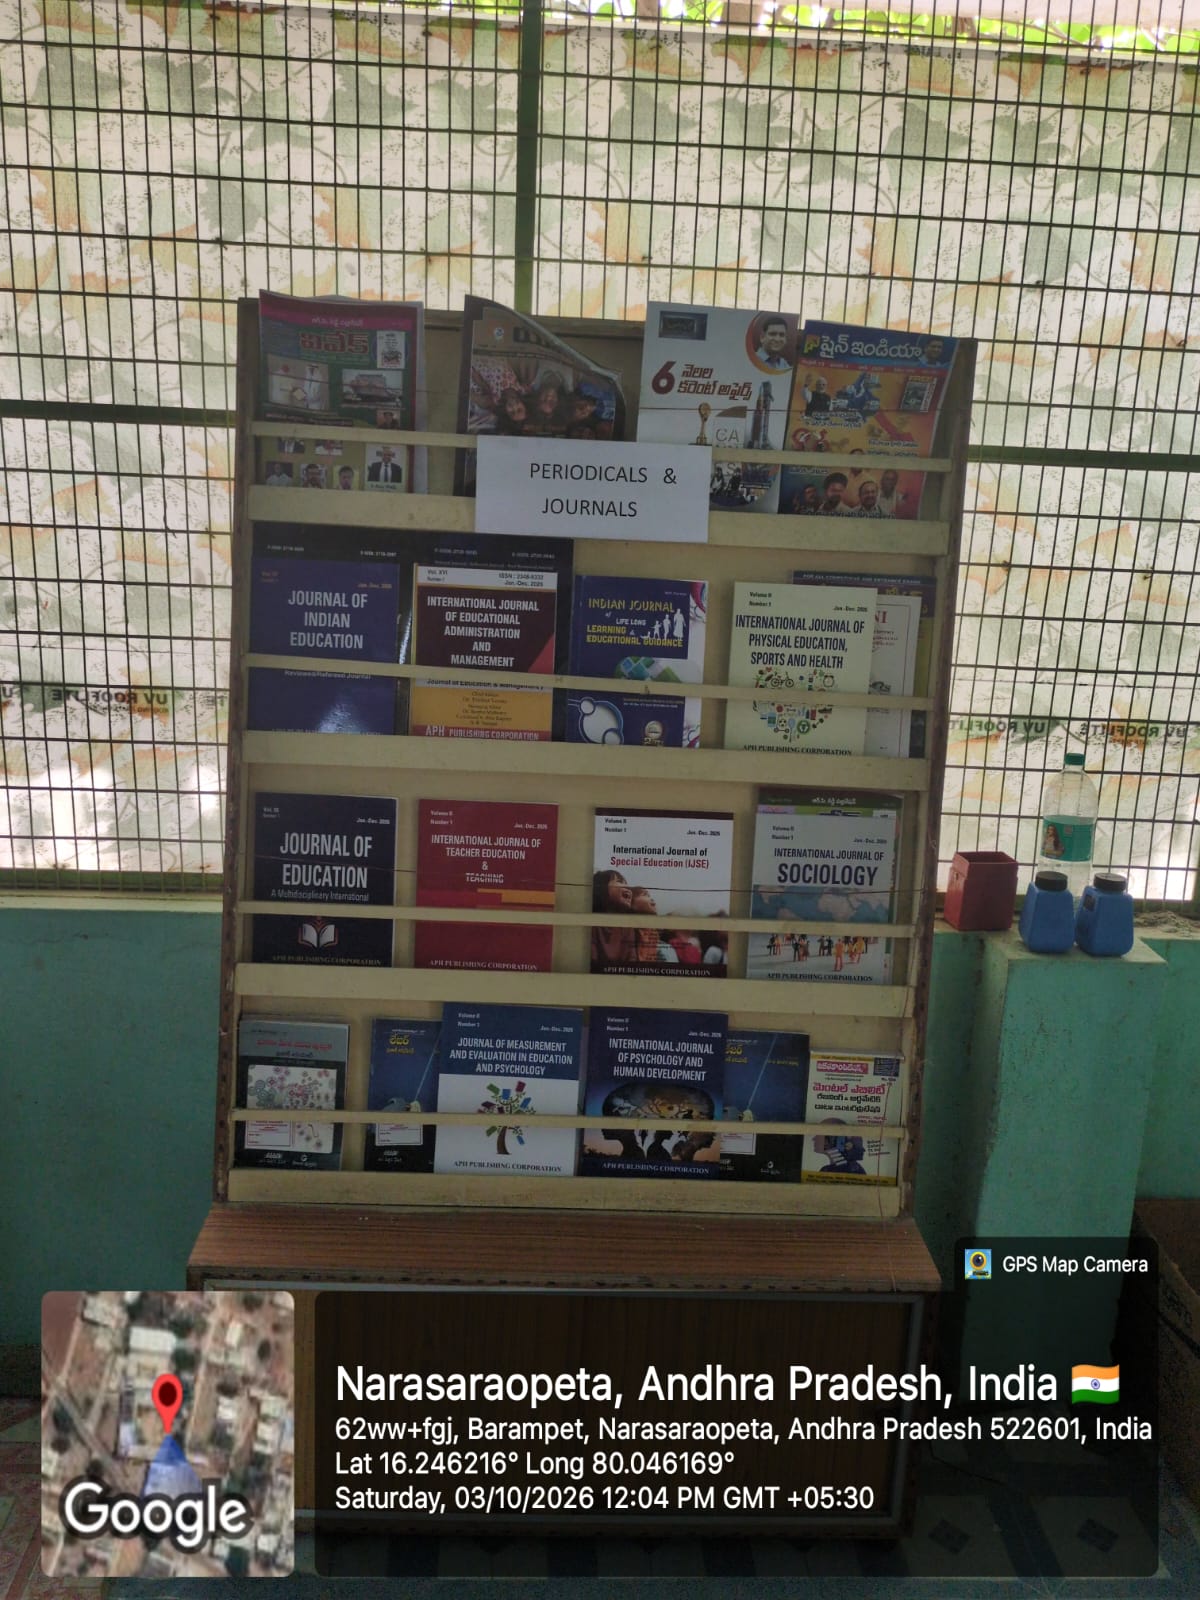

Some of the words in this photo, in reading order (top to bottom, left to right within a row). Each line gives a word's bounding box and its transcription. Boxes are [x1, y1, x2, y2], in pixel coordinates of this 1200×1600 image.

[851, 339, 923, 358] ఇండియా
[652, 361, 676, 395] 6
[715, 427, 739, 441] CA
[530, 463, 648, 483] PERIODICALS
[663, 467, 677, 484] &
[542, 498, 637, 517] JOURNALS
[288, 590, 348, 607] JOURNAL
[352, 593, 368, 608] OF
[427, 596, 497, 609] INTERNATIONAL
[498, 600, 539, 611] JOURNAL
[588, 598, 625, 610] INDIAN
[629, 600, 675, 612] JOURNAL
[304, 612, 350, 628] INDIAN
[445, 611, 458, 621] OF
[460, 612, 520, 625] EDUCATIONAL
[735, 615, 807, 631] INTERNATIONAL
[808, 618, 851, 633] JOURNAL
[853, 620, 865, 634] OF
[444, 625, 520, 638] ADMINISTRATION
[586, 624, 626, 634] LEARNING
[290, 632, 363, 648] EDUCATION
[472, 641, 491, 651] AND
[586, 635, 641, 646] EDUCATIONAL
[643, 638, 684, 648] GUIDANCE
[749, 633, 792, 649] PHYSICAL
[794, 636, 848, 652] EDUCATION,
[450, 654, 515, 667] MANAGEMENT
[751, 652, 785, 666] SPORTS
[787, 654, 807, 667] AND
[809, 655, 843, 669] HEALTH
[425, 725, 444, 737] APH
[449, 729, 490, 739] PUBLISHING
[491, 730, 539, 741] CORPORATION
[758, 746, 800, 754] PUBLISHING
[801, 747, 852, 756] CORPORATION
[280, 832, 350, 857] JOURNAL
[354, 836, 372, 858] OF
[431, 834, 492, 845] INTERNATIONAL
[493, 837, 530, 848] JOURNAL
[532, 838, 541, 848] OF
[446, 847, 480, 857] TEACHER
[481, 848, 525, 860] EDUCATION
[613, 844, 664, 855] International
[666, 847, 697, 856] Journal
[699, 847, 707, 856] of
[774, 848, 835, 859] INTERNATIONAL
[836, 849, 872, 861] JOURNAL
[874, 851, 885, 861] OF
[481, 861, 488, 870] &
[610, 857, 641, 867] Special
[643, 858, 683, 868] Education
[685, 858, 710, 869] (IJSE)
[282, 864, 367, 888] EDUCATION
[465, 873, 504, 884] TEACHING
[777, 863, 878, 886] SOCIOLOGY
[271, 889, 276, 897] A
[330, 892, 369, 902] International
[445, 960, 487, 968] PUBLISHING
[487, 962, 537, 970] CORPORATION
[660, 968, 711, 976] CORPORATION
[823, 974, 873, 982] CORPORATION
[458, 1037, 494, 1048] JOURNAL
[496, 1039, 506, 1049] OF
[506, 1040, 567, 1052] MEASUREMENT
[609, 1038, 675, 1052] INTERNATIONAL
[675, 1043, 714, 1054] JOURNAL
[449, 1049, 467, 1059] AND
[468, 1051, 517, 1061] EVALUATION
[518, 1052, 527, 1062] IN
[528, 1053, 573, 1065] EDUCATION
[618, 1052, 630, 1063] OF
[629, 1053, 683, 1066] PSYCHOLOGY
[685, 1056, 703, 1067] AND
[476, 1063, 493, 1073] AND
[494, 1064, 546, 1076] PSYCHOLOGY
[613, 1066, 645, 1077] HUMAN
[646, 1067, 707, 1081] DEVELOPMENT
[469, 1161, 511, 1169] PUBLISHING
[511, 1163, 562, 1172] CORPORATION
[617, 1163, 658, 1171] PUBLISHING
[659, 1165, 710, 1174] CORPORATION
